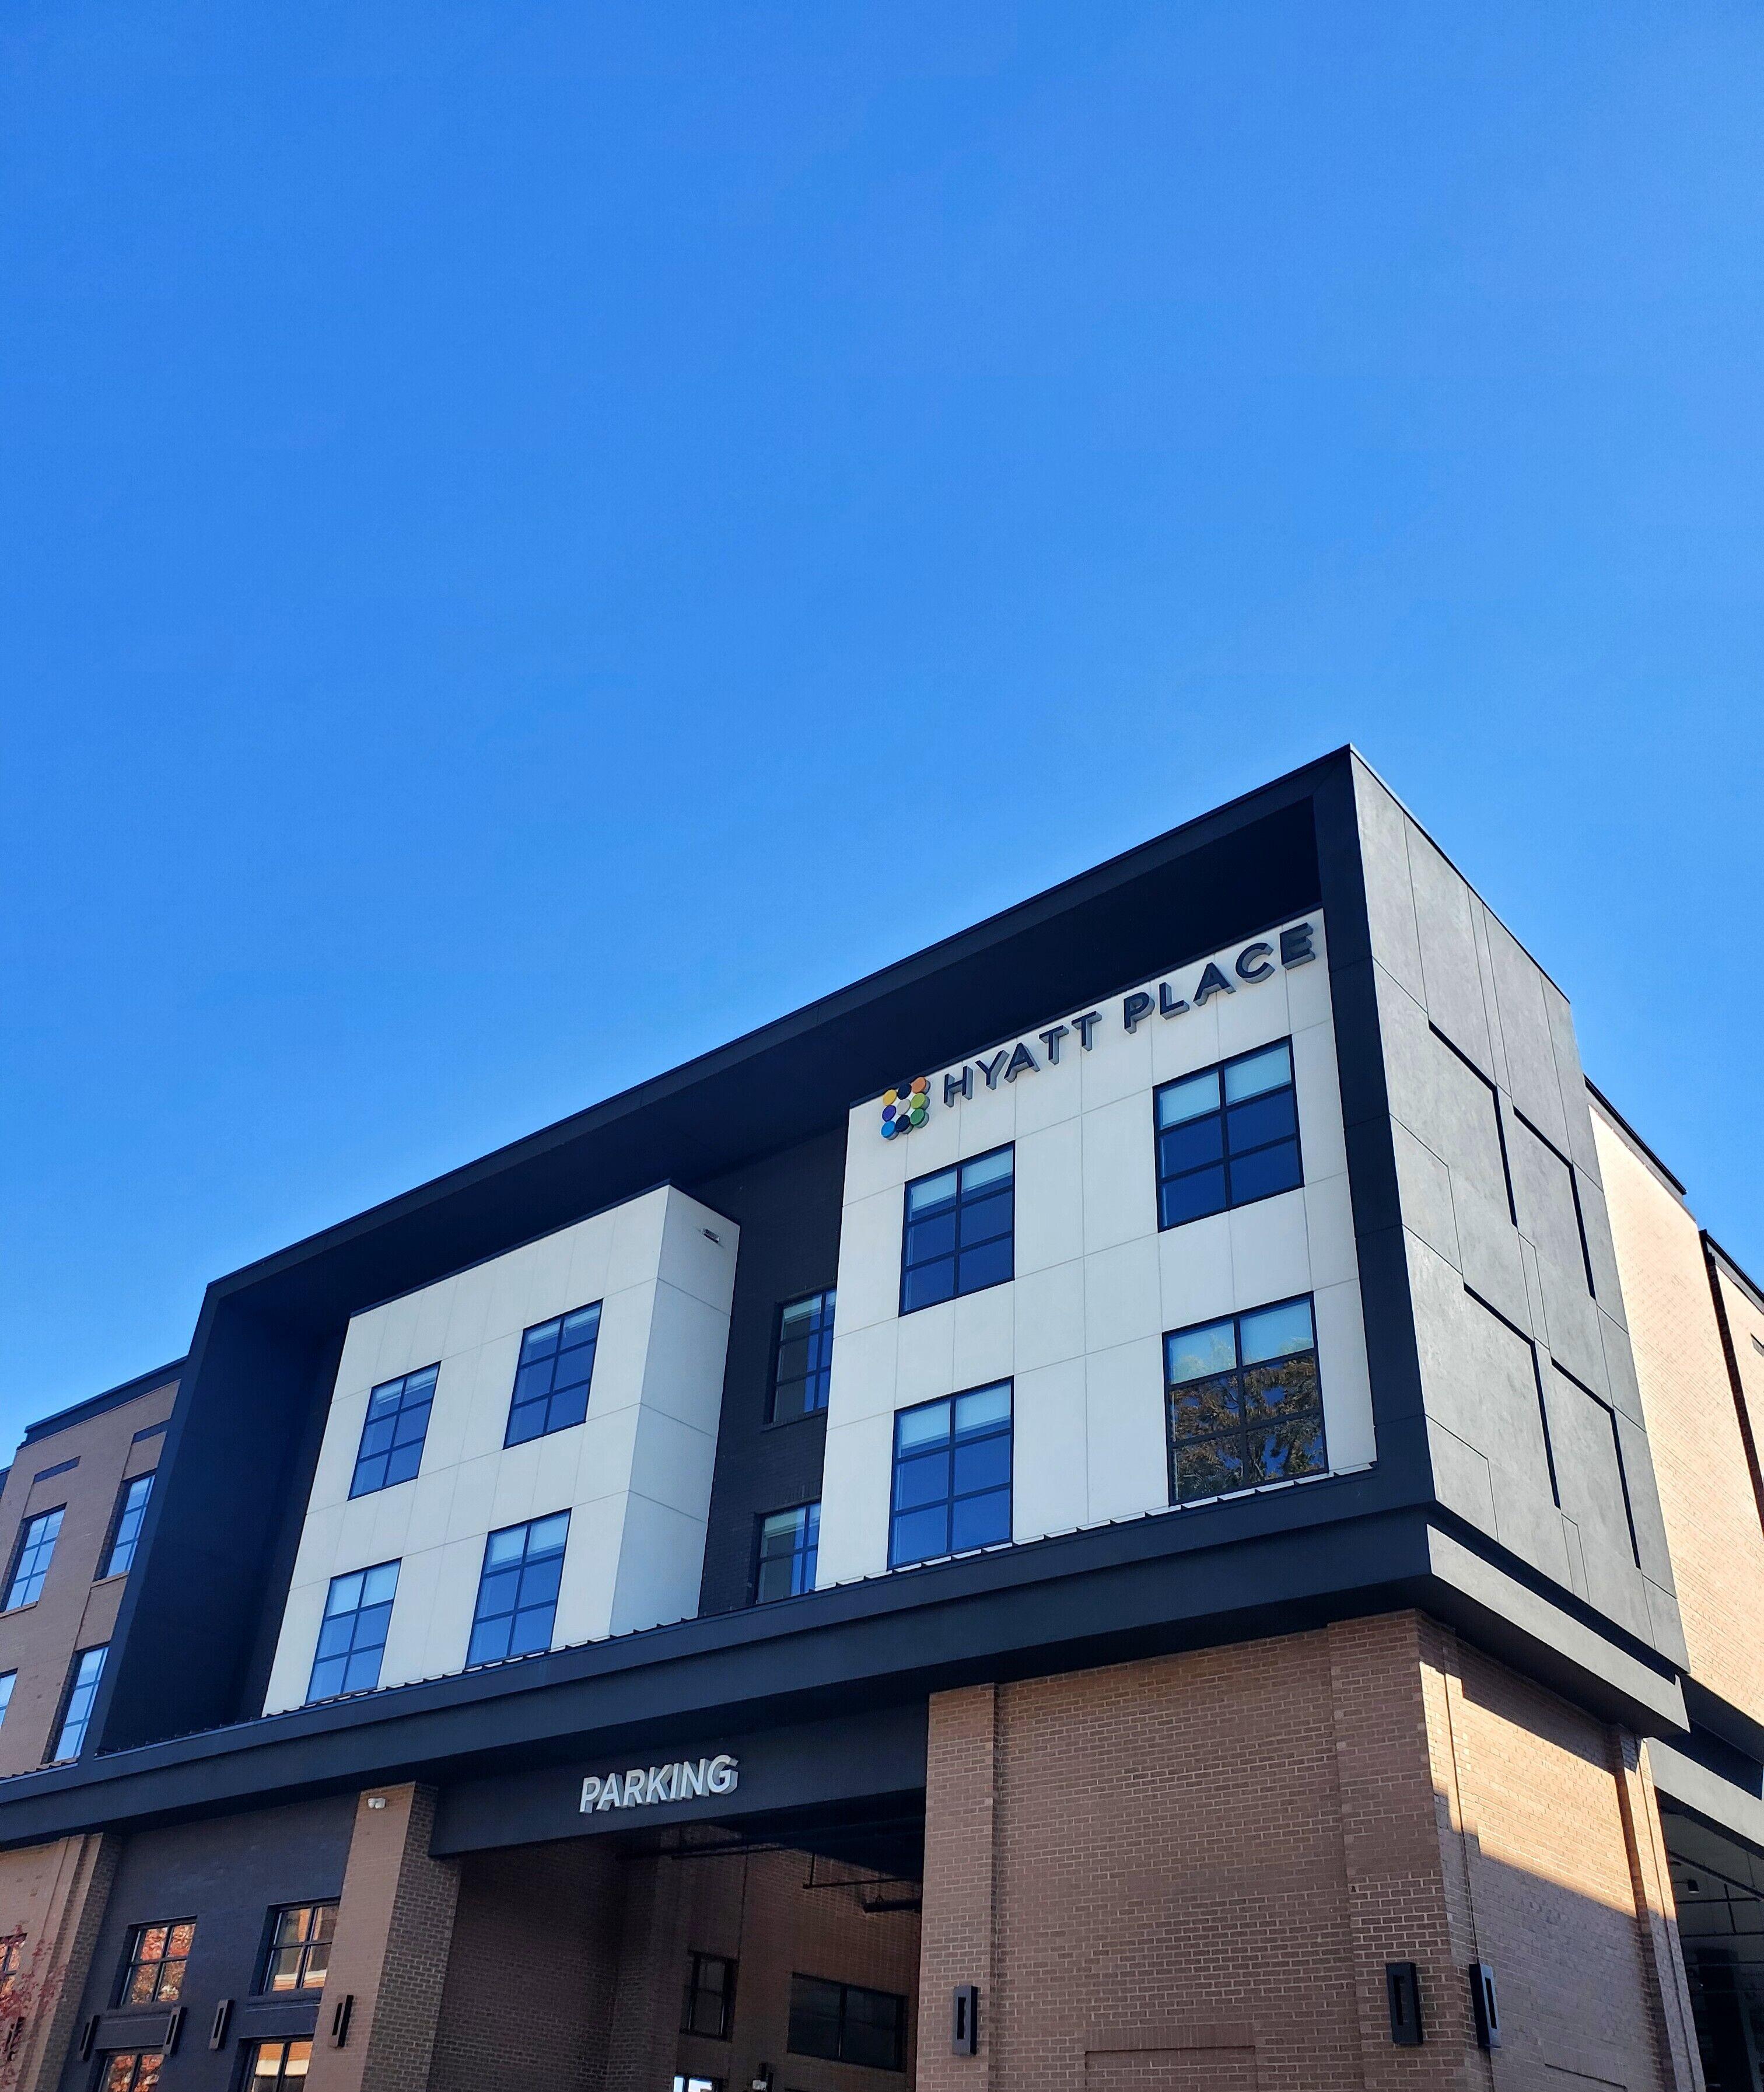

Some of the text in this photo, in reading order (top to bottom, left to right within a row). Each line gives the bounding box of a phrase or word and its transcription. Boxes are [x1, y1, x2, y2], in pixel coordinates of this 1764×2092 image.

[943, 922, 1315, 1107] HYATT PLACE
[579, 1754, 738, 1814] PARKING
